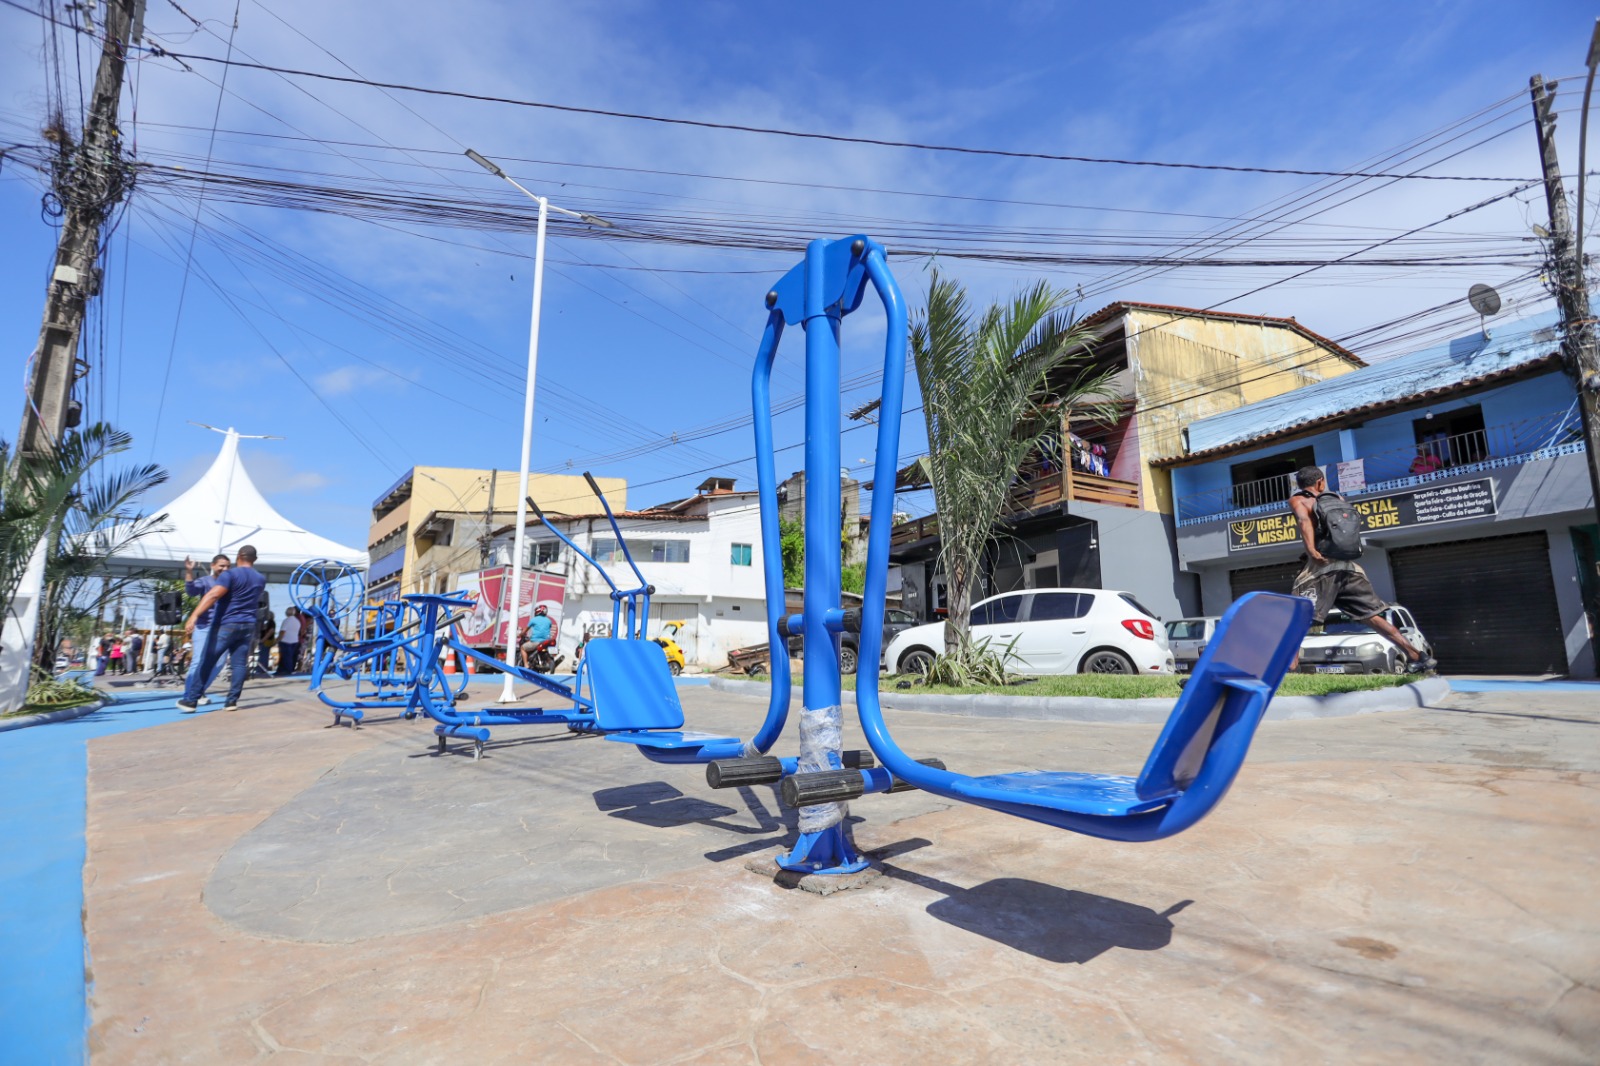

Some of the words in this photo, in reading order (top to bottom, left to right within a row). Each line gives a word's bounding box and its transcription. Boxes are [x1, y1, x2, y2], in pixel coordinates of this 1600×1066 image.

[1464, 498, 1491, 507] Libertação
[1256, 514, 1297, 531] IGREJA
[1257, 527, 1296, 544] MISSÃO
[1367, 512, 1400, 528] SEDE
